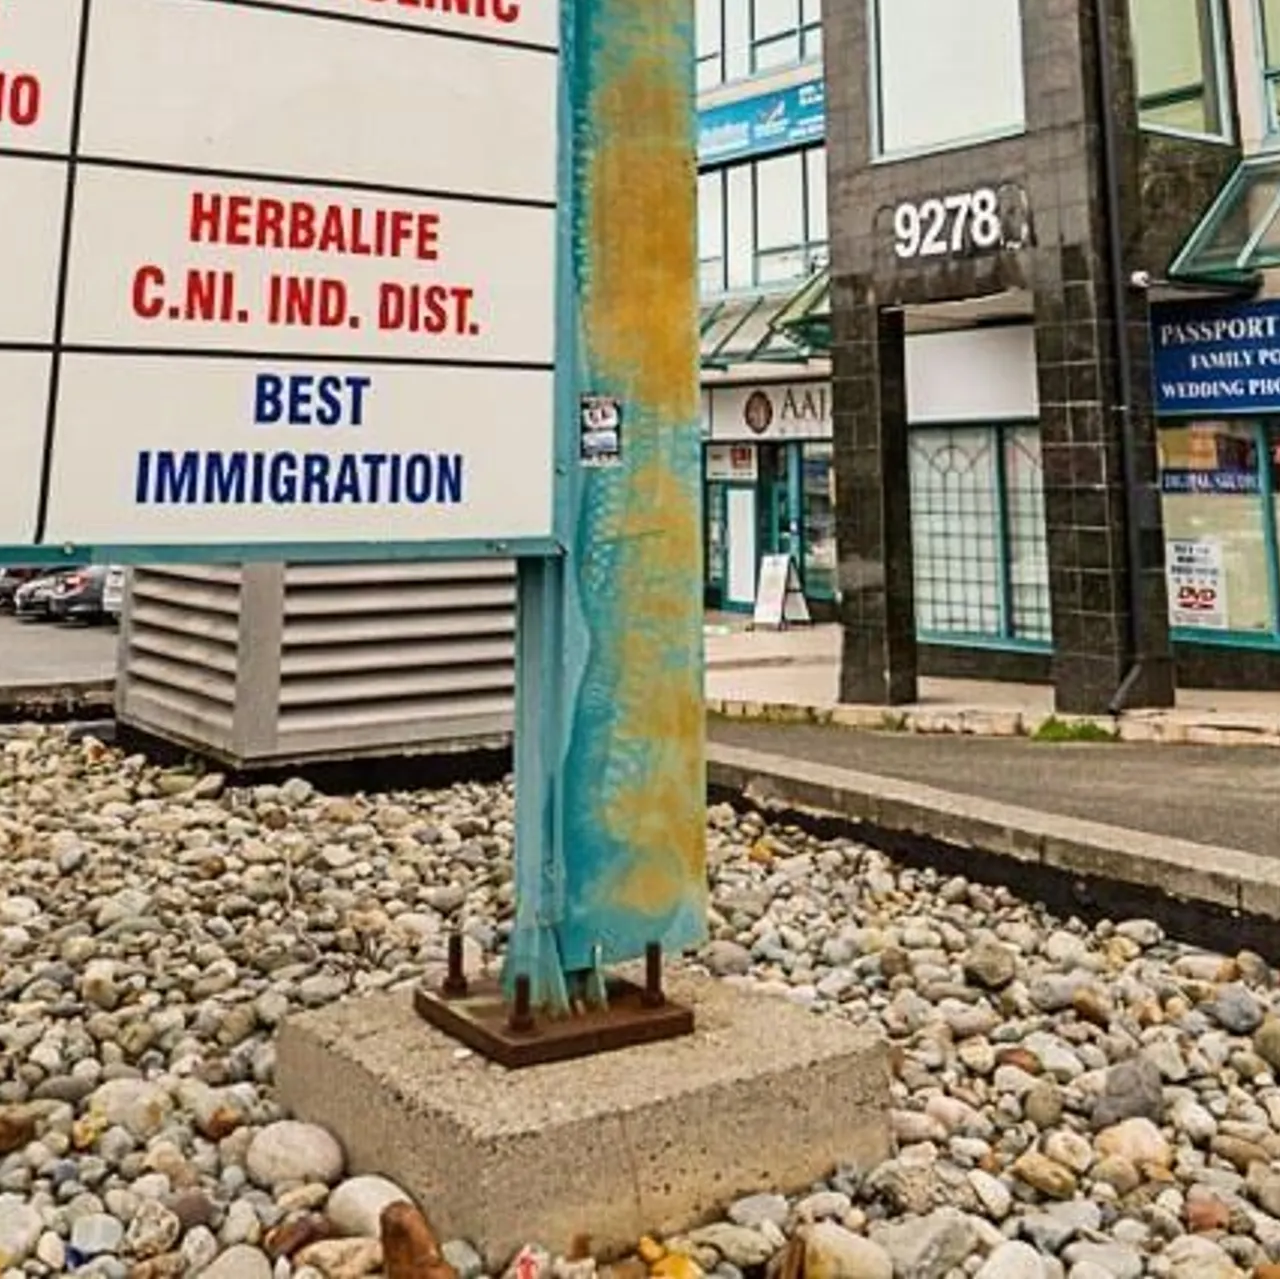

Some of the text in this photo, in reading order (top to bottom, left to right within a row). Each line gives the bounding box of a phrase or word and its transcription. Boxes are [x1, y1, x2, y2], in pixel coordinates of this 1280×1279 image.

[189, 191, 441, 262] HERBALIFE
[895, 188, 1000, 257] 9278
[267, 280, 362, 329] IND.
[376, 282, 481, 335] DIST.
[1160, 316, 1278, 345] PASSPORT
[1190, 352, 1255, 370] FAMILY
[252, 374, 371, 426] BEST
[1162, 379, 1245, 399] WEDDING
[134, 451, 465, 505] IMMIGRATION
